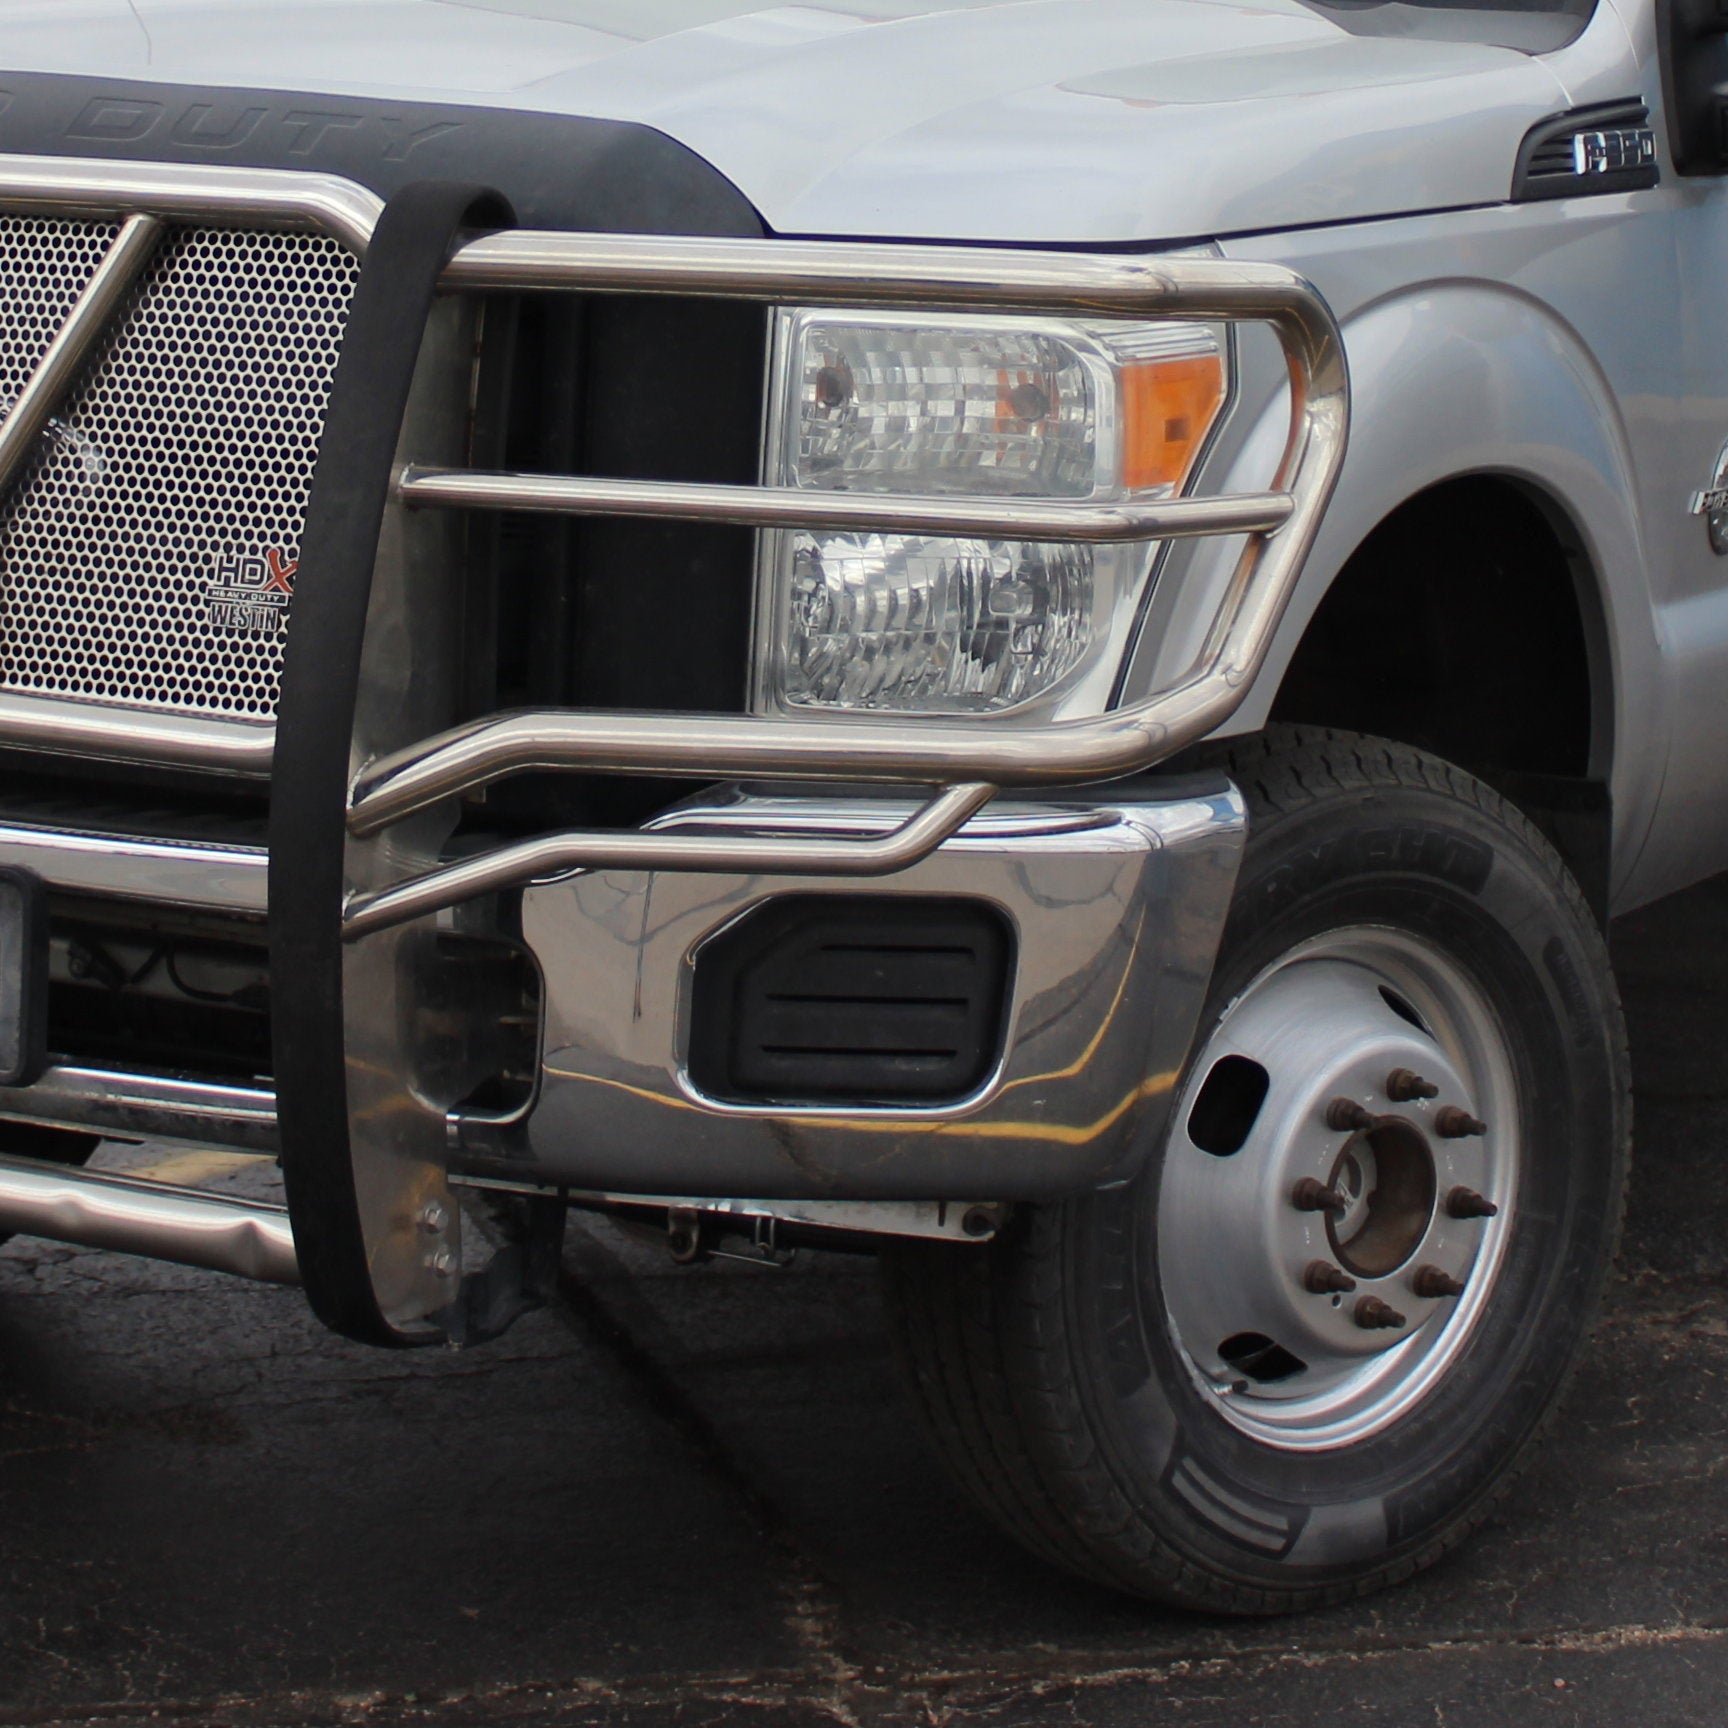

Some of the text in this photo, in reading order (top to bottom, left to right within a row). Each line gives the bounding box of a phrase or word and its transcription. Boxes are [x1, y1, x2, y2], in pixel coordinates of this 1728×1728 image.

[65, 96, 464, 161] DUTY
[215, 547, 300, 593] HDX
[211, 588, 280, 603] HEAVY DUTY
